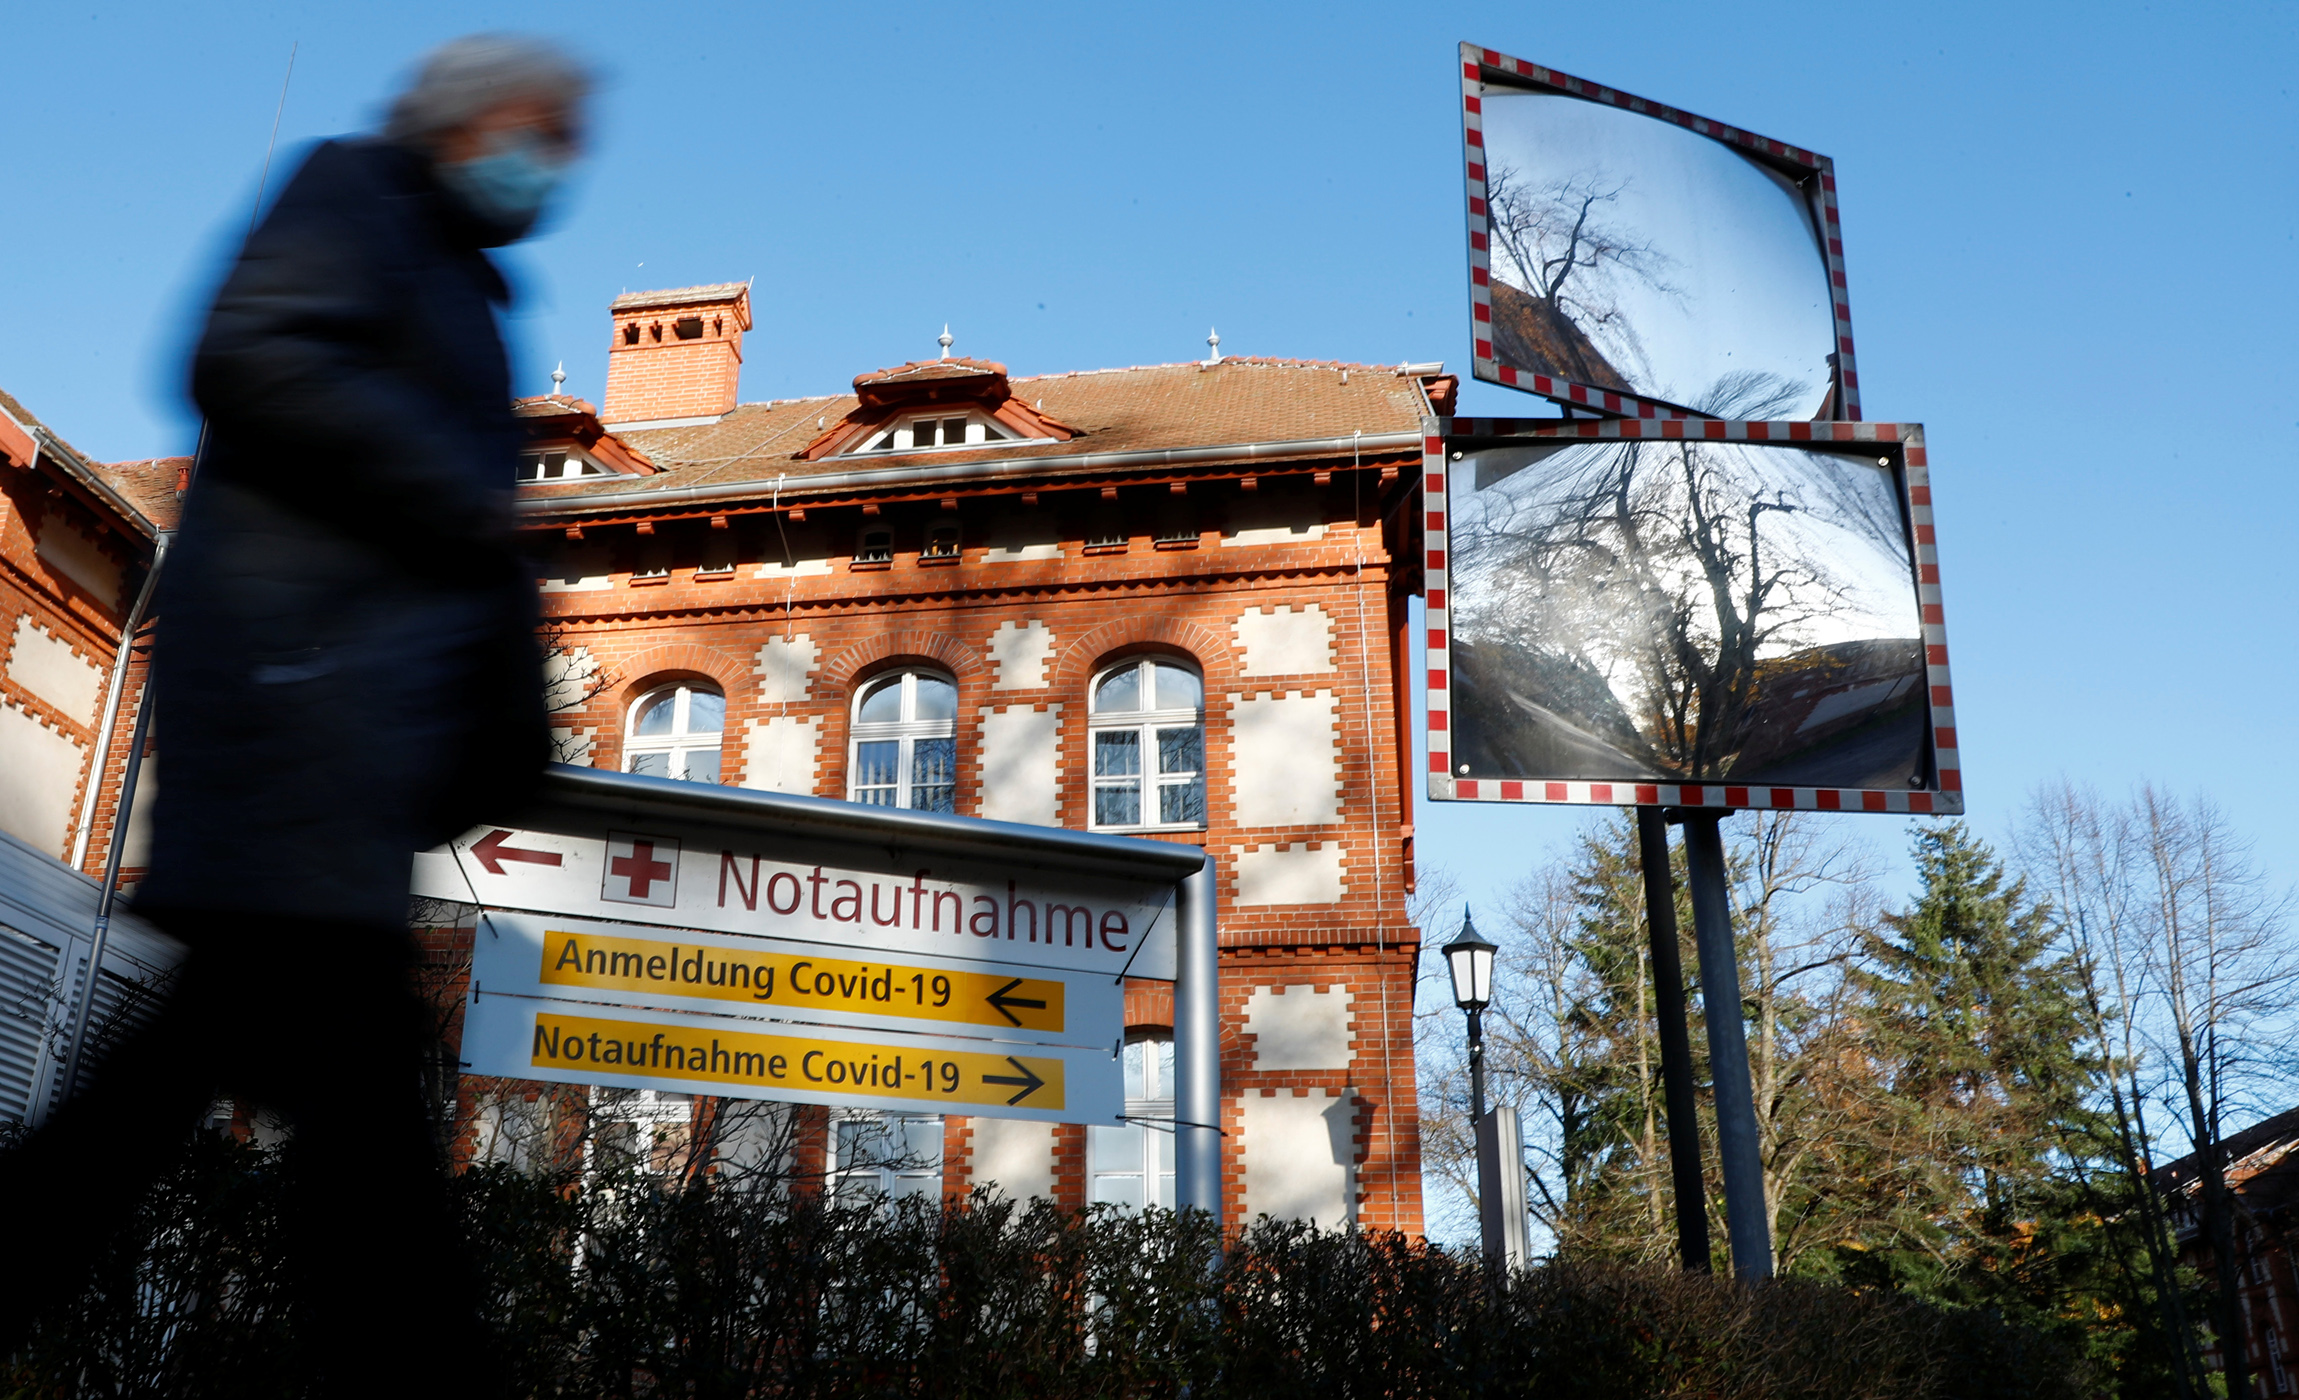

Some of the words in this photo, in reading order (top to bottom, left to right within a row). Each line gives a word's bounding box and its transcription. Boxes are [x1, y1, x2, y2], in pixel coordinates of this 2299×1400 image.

[717, 849, 1130, 954] Notaufnahme
[554, 938, 775, 1000] Anmeldung
[788, 961, 953, 1008] Covid-19
[532, 1023, 788, 1080] Notaufnahme
[802, 1049, 961, 1095] Covid-19
